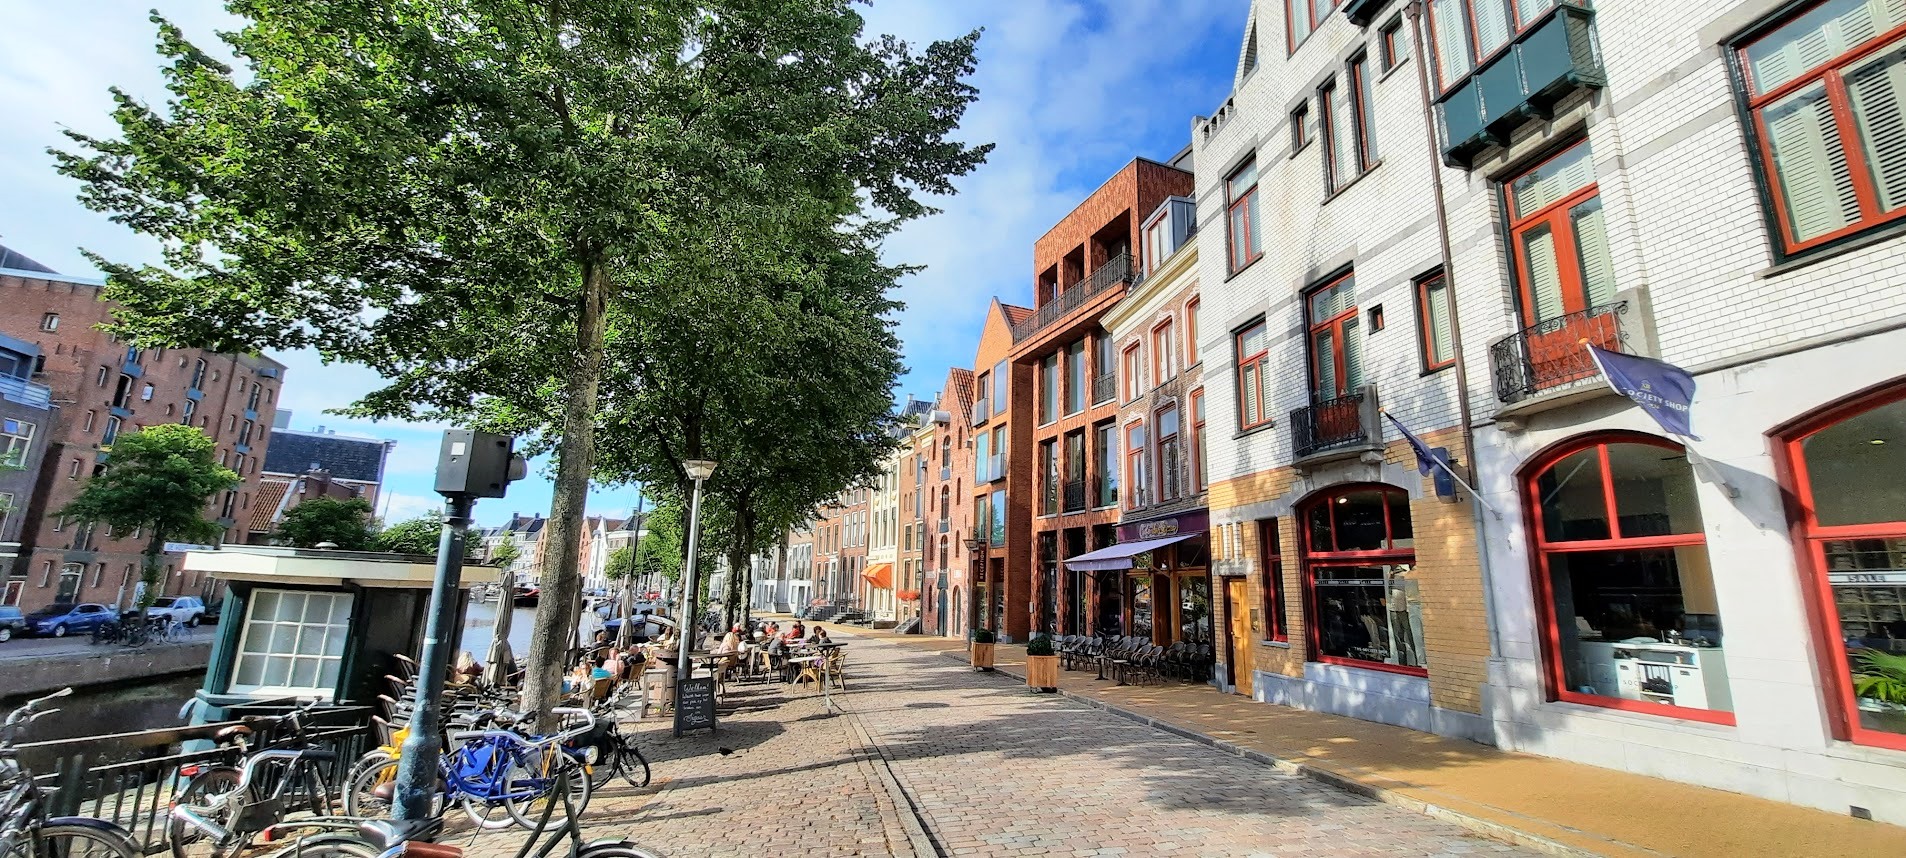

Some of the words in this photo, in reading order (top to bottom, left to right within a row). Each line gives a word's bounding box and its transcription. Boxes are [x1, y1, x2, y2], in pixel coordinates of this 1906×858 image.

[1622, 387, 1663, 403] OCIETY
[1664, 400, 1688, 411] SHOP
[1849, 574, 1885, 582] SALE
